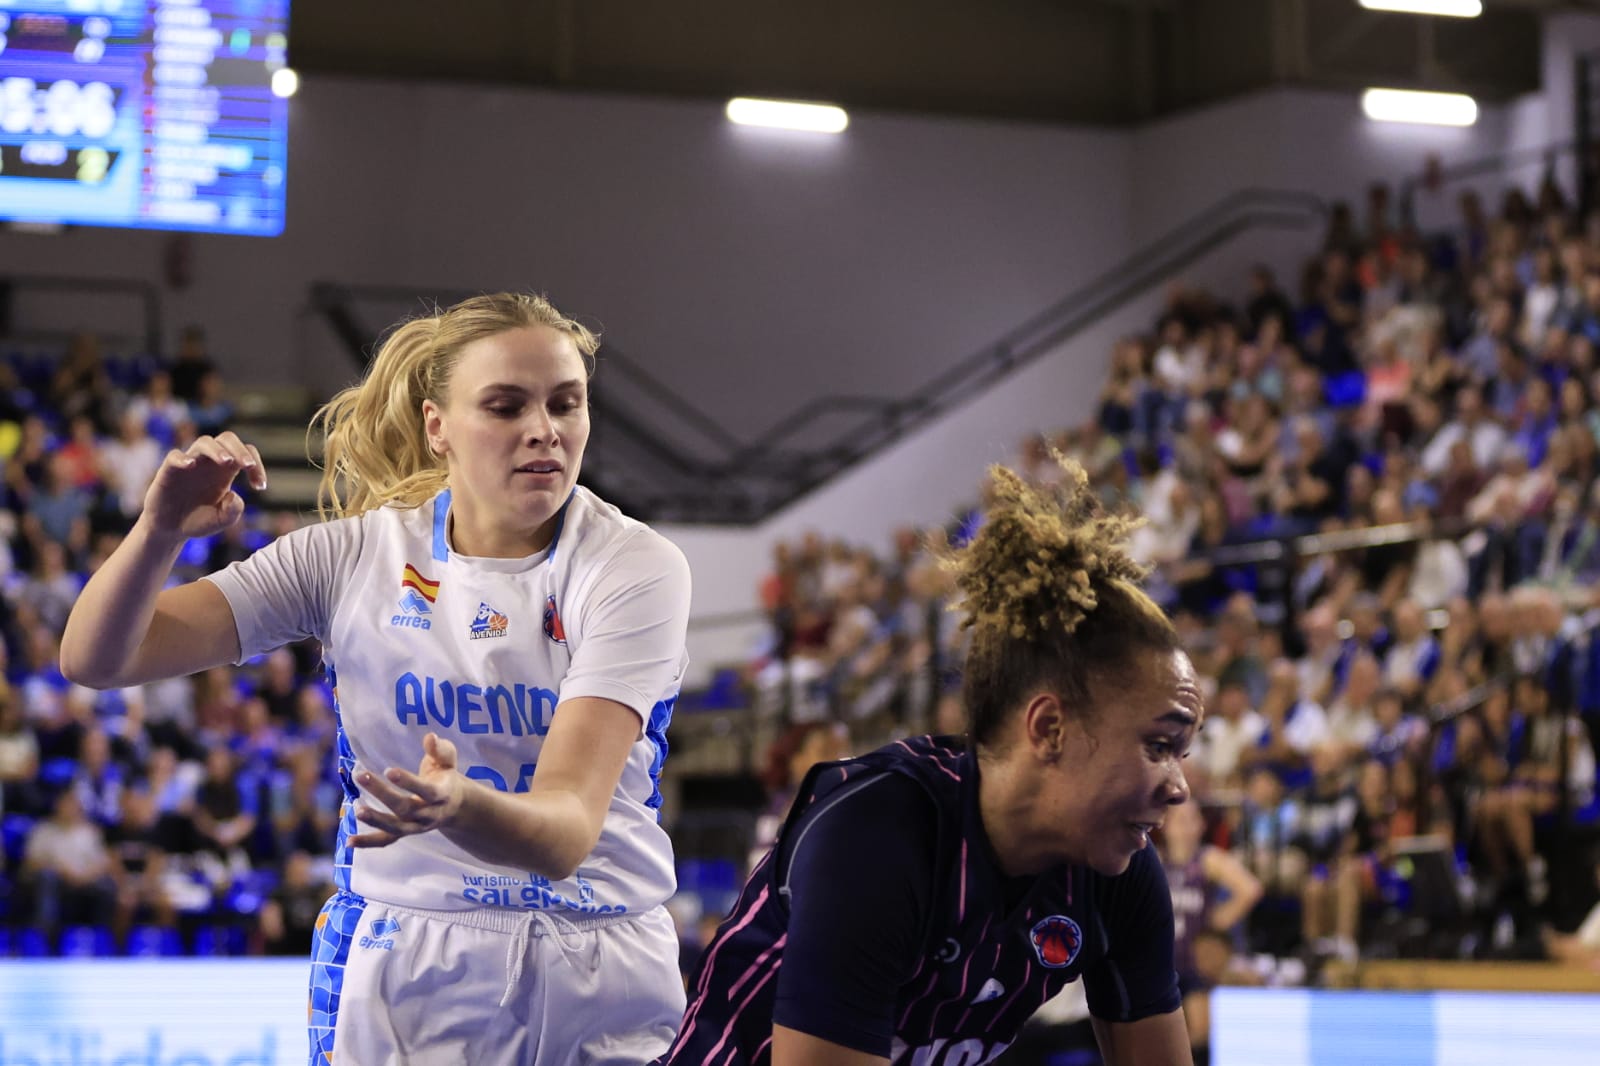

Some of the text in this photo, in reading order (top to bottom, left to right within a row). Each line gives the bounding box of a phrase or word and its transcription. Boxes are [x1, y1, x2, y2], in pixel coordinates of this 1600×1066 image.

[391, 614, 432, 630] errea
[469, 628, 508, 640] AVENIDA
[395, 671, 559, 736] AVENID
